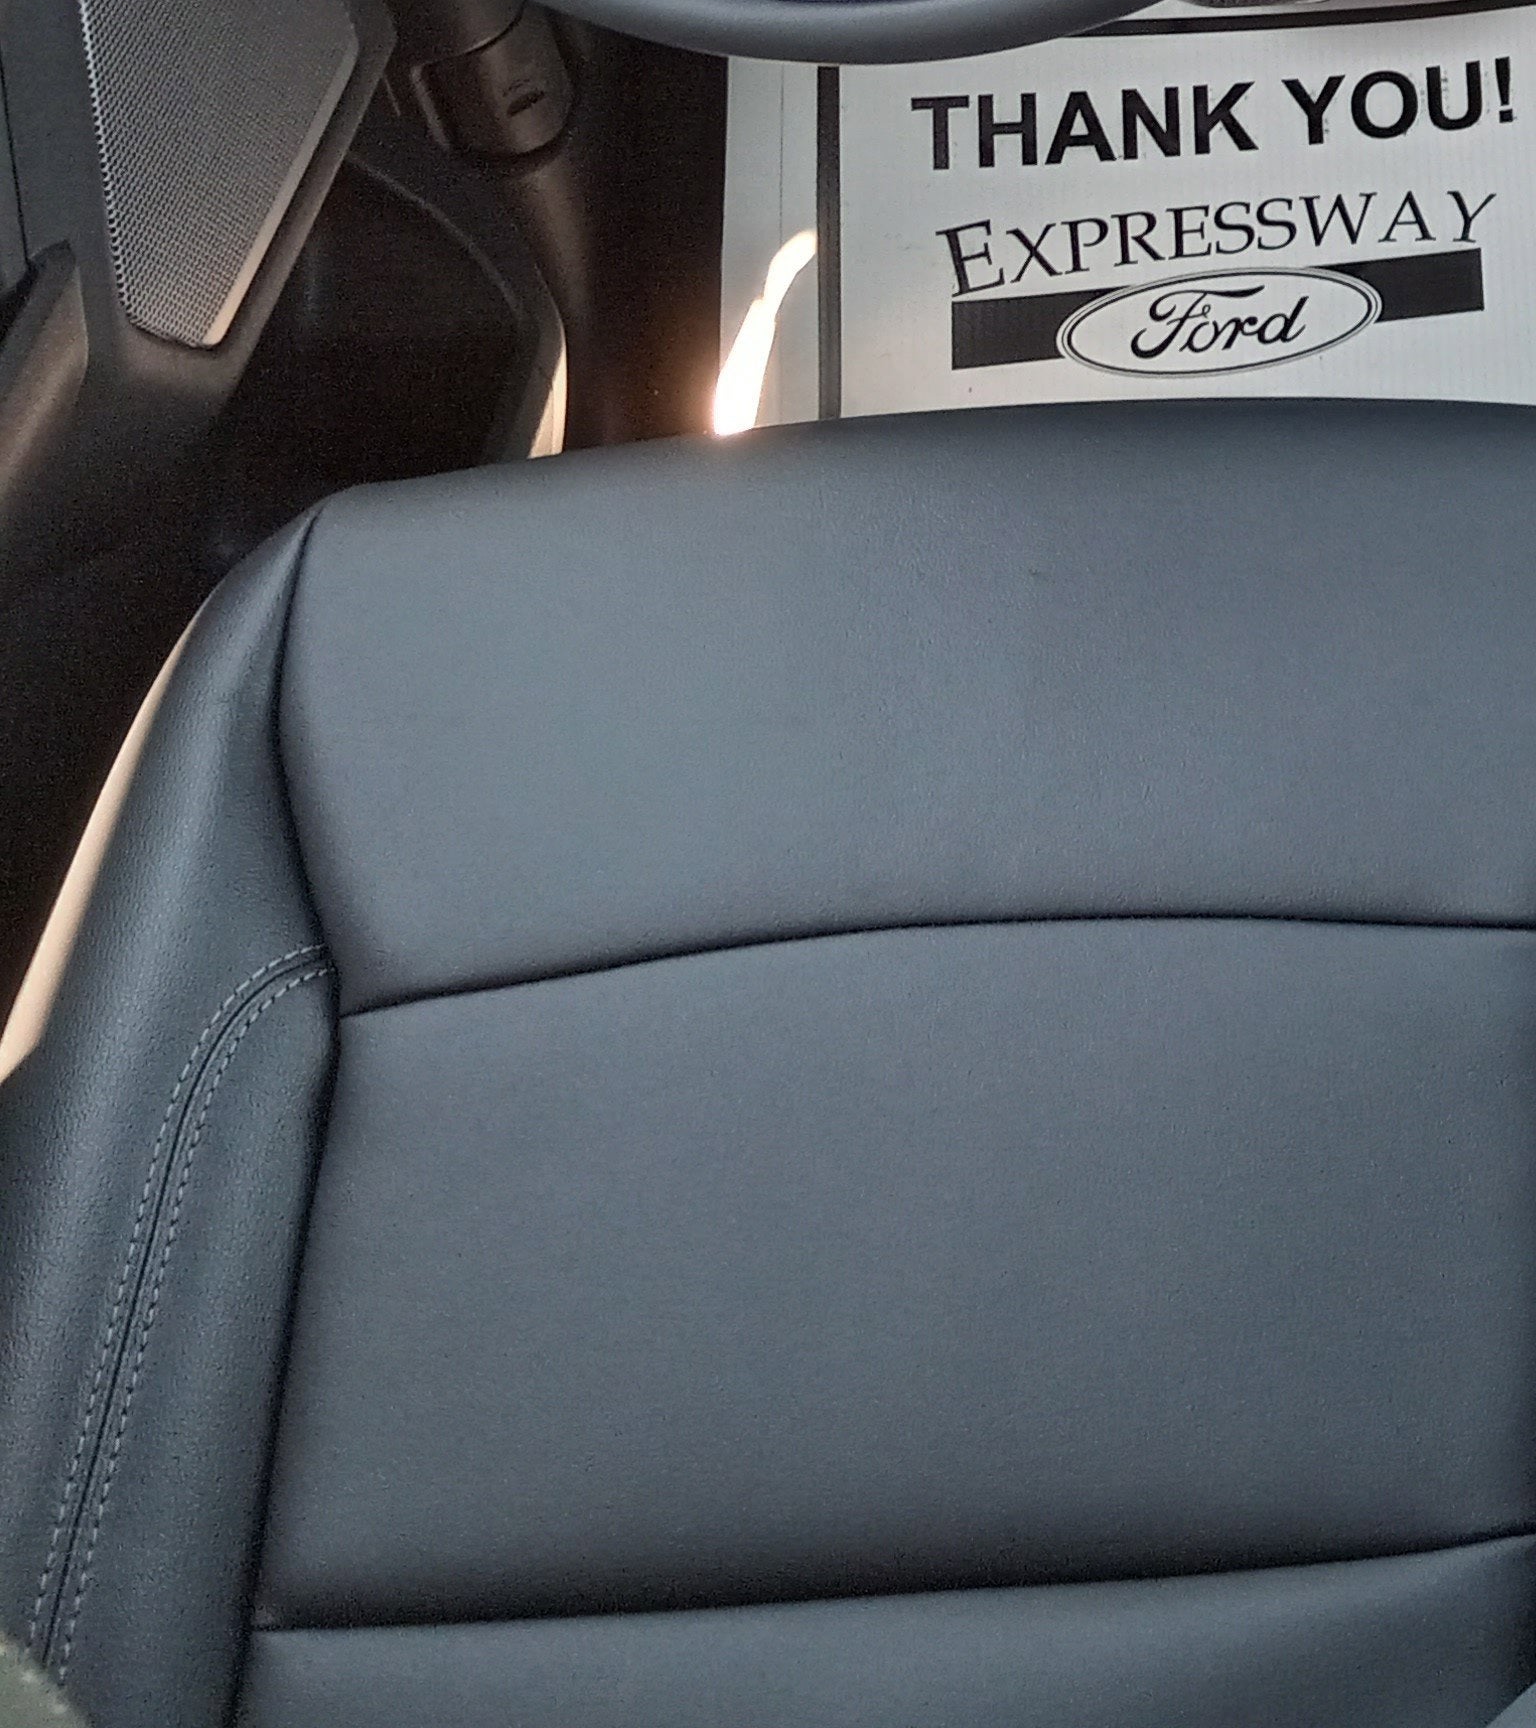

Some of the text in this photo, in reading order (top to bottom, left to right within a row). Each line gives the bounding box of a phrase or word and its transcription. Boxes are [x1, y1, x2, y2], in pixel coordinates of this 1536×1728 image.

[910, 55, 1516, 172] THANK YOU!
[1129, 283, 1310, 360] Ford
